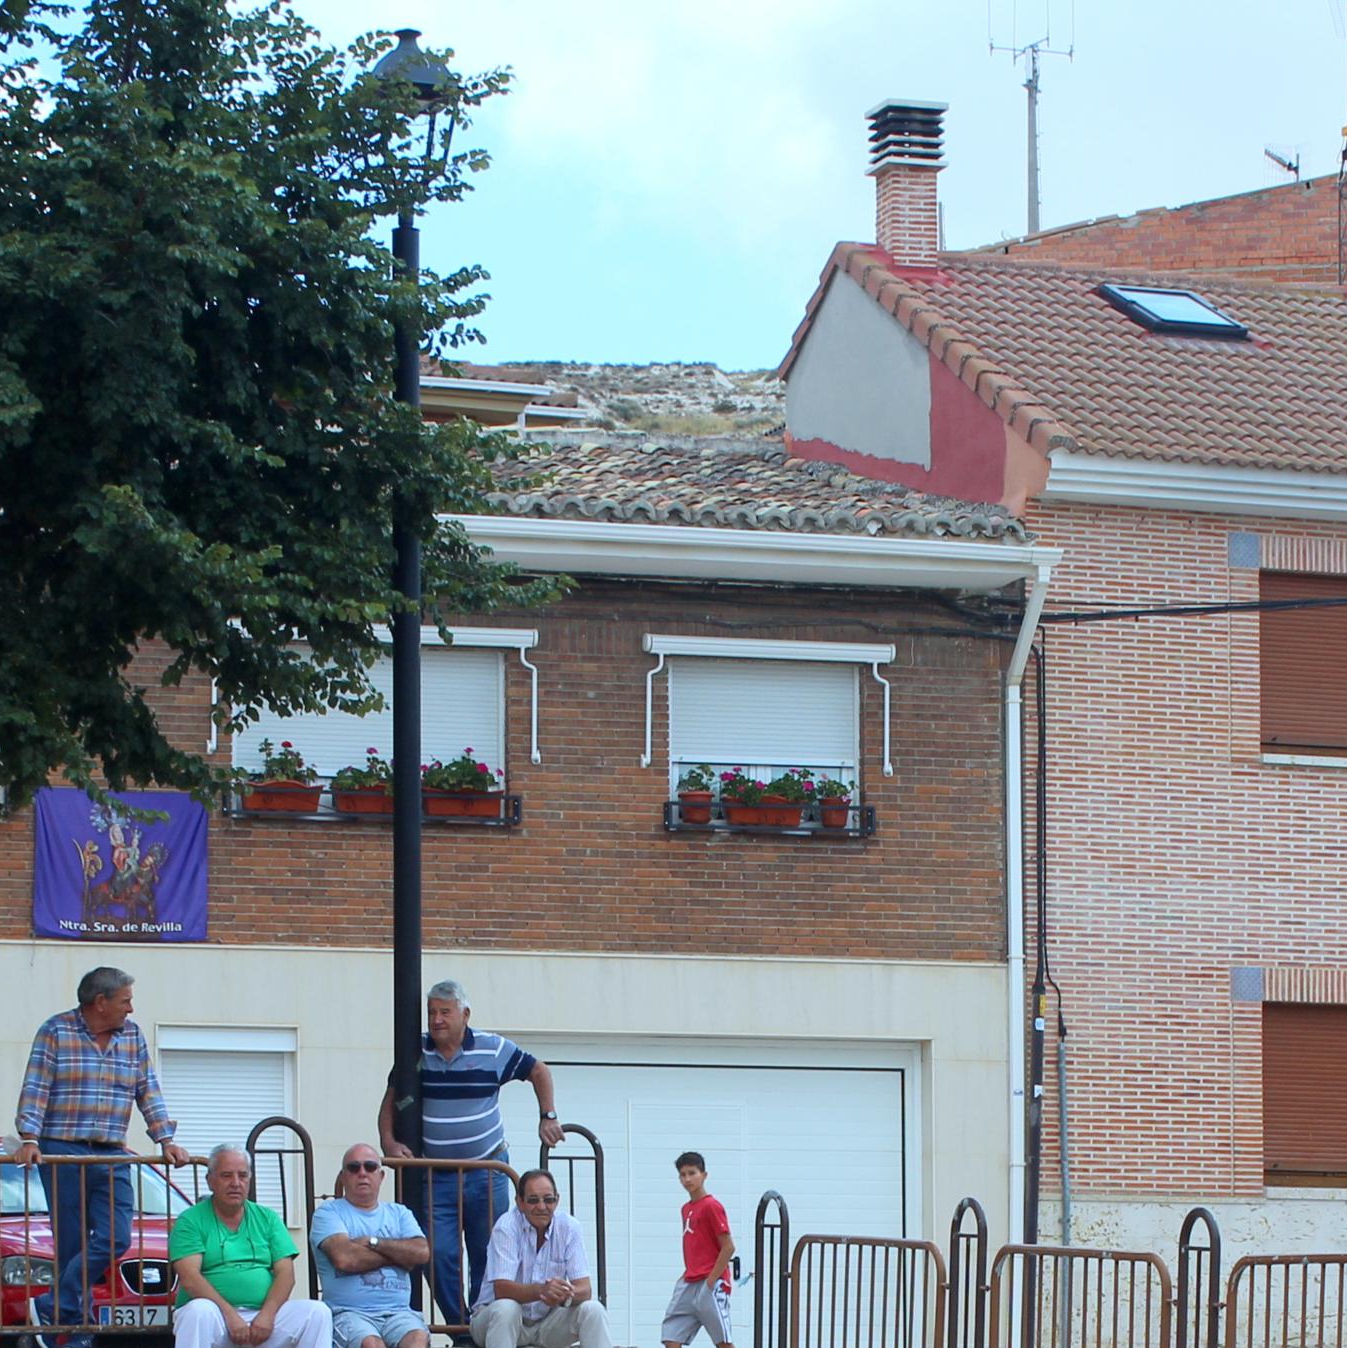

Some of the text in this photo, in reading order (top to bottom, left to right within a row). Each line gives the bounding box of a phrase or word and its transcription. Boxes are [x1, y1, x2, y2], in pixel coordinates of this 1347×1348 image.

[59, 919, 183, 932] Ntra. Sra. de Revilla
